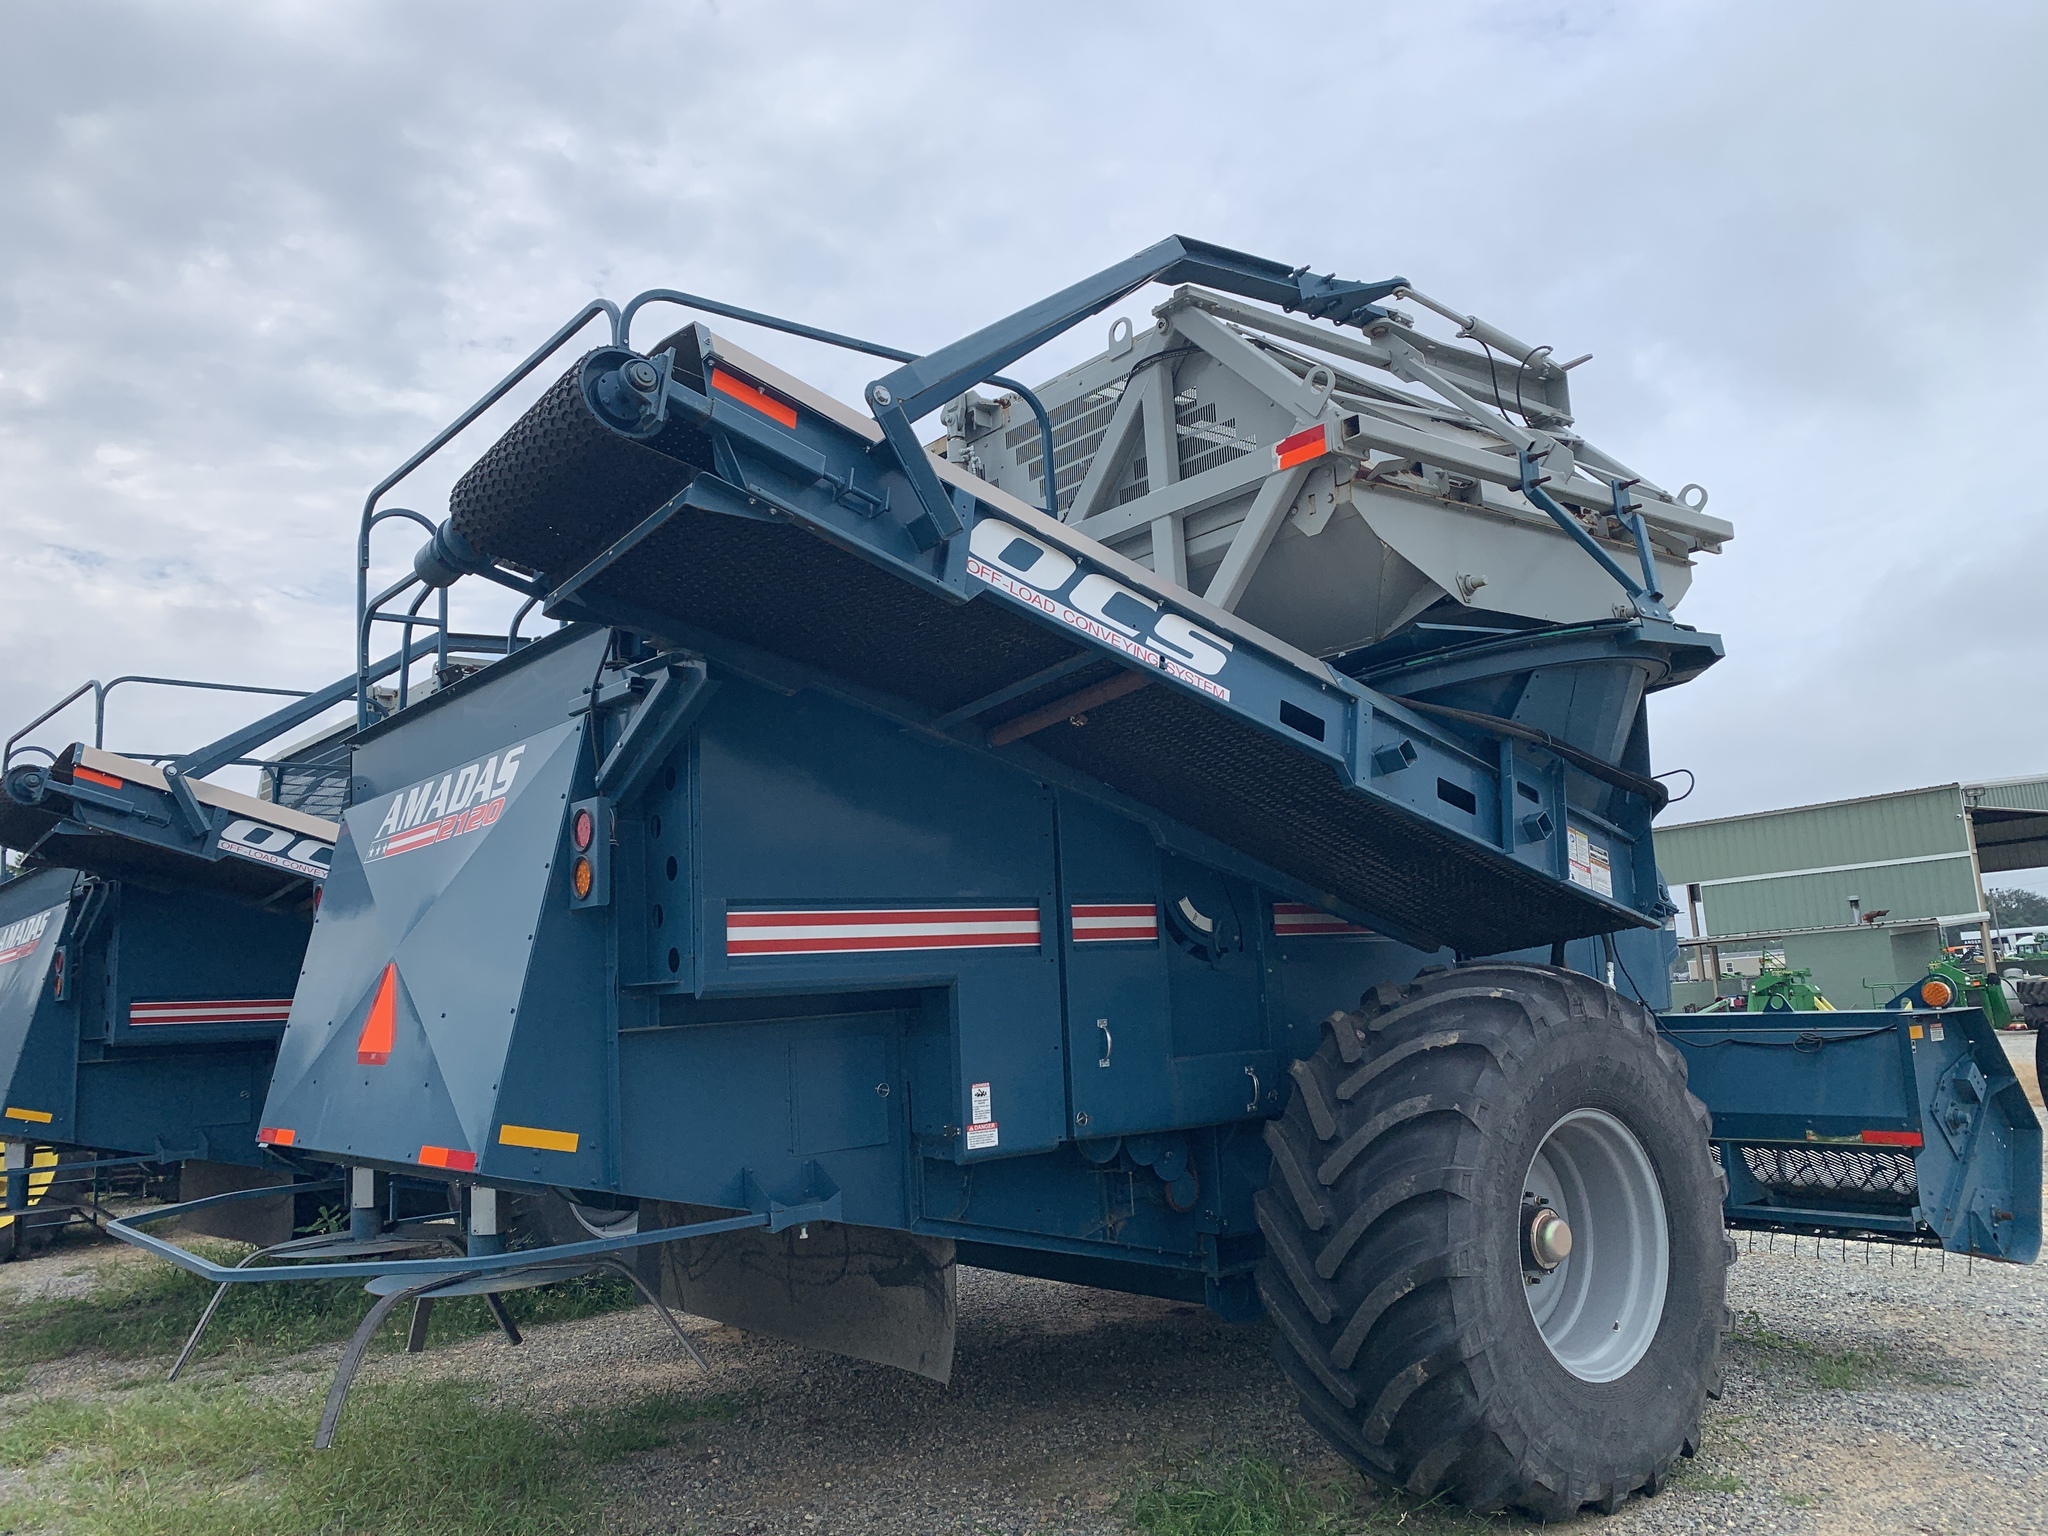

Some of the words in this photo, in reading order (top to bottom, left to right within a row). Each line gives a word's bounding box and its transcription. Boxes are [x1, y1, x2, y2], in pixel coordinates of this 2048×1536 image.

[967, 559, 1055, 613] OFF-LOAD
[1063, 609, 1158, 666] CONVEYING
[1166, 661, 1225, 699] SYSTEM
[969, 518, 1233, 676] OCS
[375, 744, 526, 839] AMADAS
[435, 797, 505, 843] 2120
[220, 842, 278, 864] OFF-LOAD
